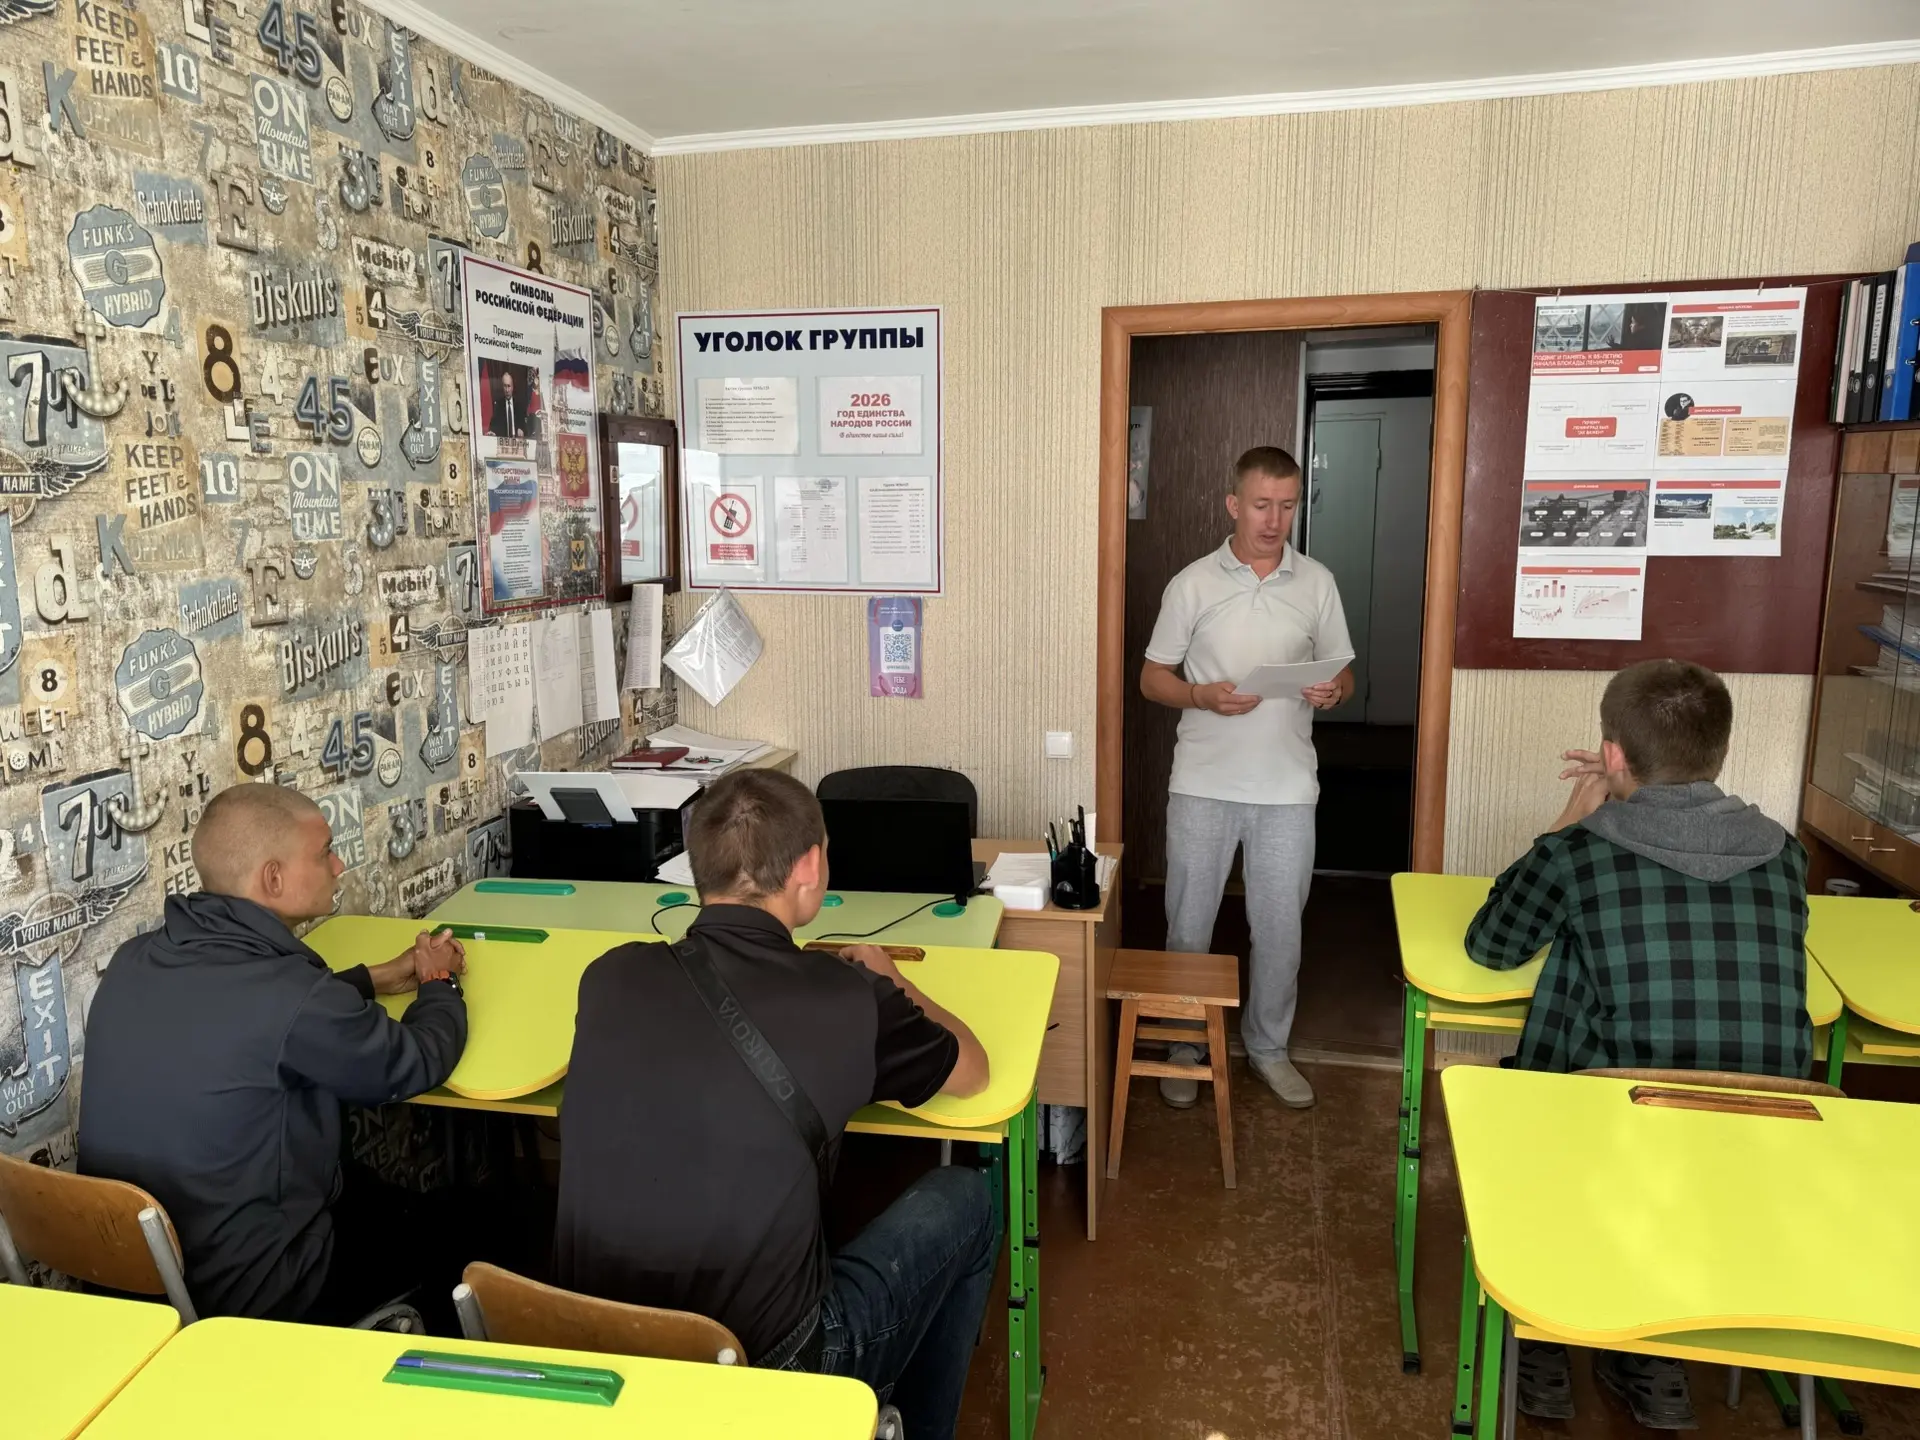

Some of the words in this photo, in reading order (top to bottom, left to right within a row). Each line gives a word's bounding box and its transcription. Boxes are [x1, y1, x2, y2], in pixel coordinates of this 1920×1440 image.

[76, 0, 138, 44] KEEP
[76, 36, 124, 66] FEET
[131, 49, 145, 68] &
[258, 0, 323, 84] 45
[92, 70, 152, 98] HANDS
[159, 46, 198, 95] 10
[391, 32, 410, 126] EXIT
[43, 61, 85, 139] K
[254, 78, 306, 134] ON
[381, 101, 398, 117] WAY
[258, 116, 309, 150] Mountain
[383, 114, 398, 128] OUT
[260, 139, 312, 180] TIME
[426, 150, 435, 168] 8
[137, 190, 203, 226] Schokolade
[550, 205, 595, 246] Biskuits
[82, 222, 134, 248] FUNK'S
[105, 250, 127, 285] G
[104, 288, 152, 317] HYBRID
[250, 266, 338, 328] Biskuits
[356, 307, 364, 325] 5
[369, 291, 386, 328] 4
[475, 289, 535, 317] РОССИЙСКОЙ
[536, 306, 584, 328] ФЕДЕРАЦИИ
[510, 281, 554, 304] СИМВОЛЫ
[474, 334, 510, 349] Российской
[510, 343, 542, 356] Федерации
[493, 325, 524, 340] Президент
[693, 330, 803, 352] УГОЛОК
[809, 327, 924, 350] ГРУППЫ
[204, 324, 242, 404] 8
[295, 373, 354, 443] 45
[421, 361, 438, 449] EXIT
[837, 410, 855, 419] ГОД
[857, 410, 905, 418] ЕДИНСТВА
[850, 394, 891, 407] 2026
[409, 433, 425, 445] WAY
[830, 420, 873, 428] НАРОДОВ
[125, 443, 184, 469] KEEP
[411, 443, 424, 454] OUT
[2, 476, 36, 491] NAME
[125, 472, 171, 503] FEET
[176, 473, 190, 490] &
[203, 460, 238, 495] 10
[290, 456, 338, 494] ON
[449, 463, 457, 480] 8
[140, 492, 197, 529] HANDS
[293, 491, 339, 508] Mountain
[293, 511, 341, 538] TIME
[96, 513, 134, 576] K
[34, 534, 89, 624] d
[181, 584, 240, 633] Schokolade
[281, 614, 363, 692] Biskuits
[380, 637, 387, 655] 5
[392, 616, 409, 650] 4
[129, 636, 178, 677] FUNK'S
[41, 668, 58, 692] 8
[150, 667, 170, 699] G
[147, 694, 193, 733] HYBRID
[441, 667, 455, 746] EXIT
[237, 704, 272, 776] 8
[321, 712, 376, 776] 45
[428, 735, 444, 748] WAY
[429, 746, 443, 758] OUT
[468, 753, 476, 768] 8
[21, 921, 50, 945] YOUR
[53, 908, 83, 934] NAME
[28, 969, 62, 1087] EXIT
[3, 1074, 37, 1098] WAY
[5, 1093, 36, 1115] OUT
